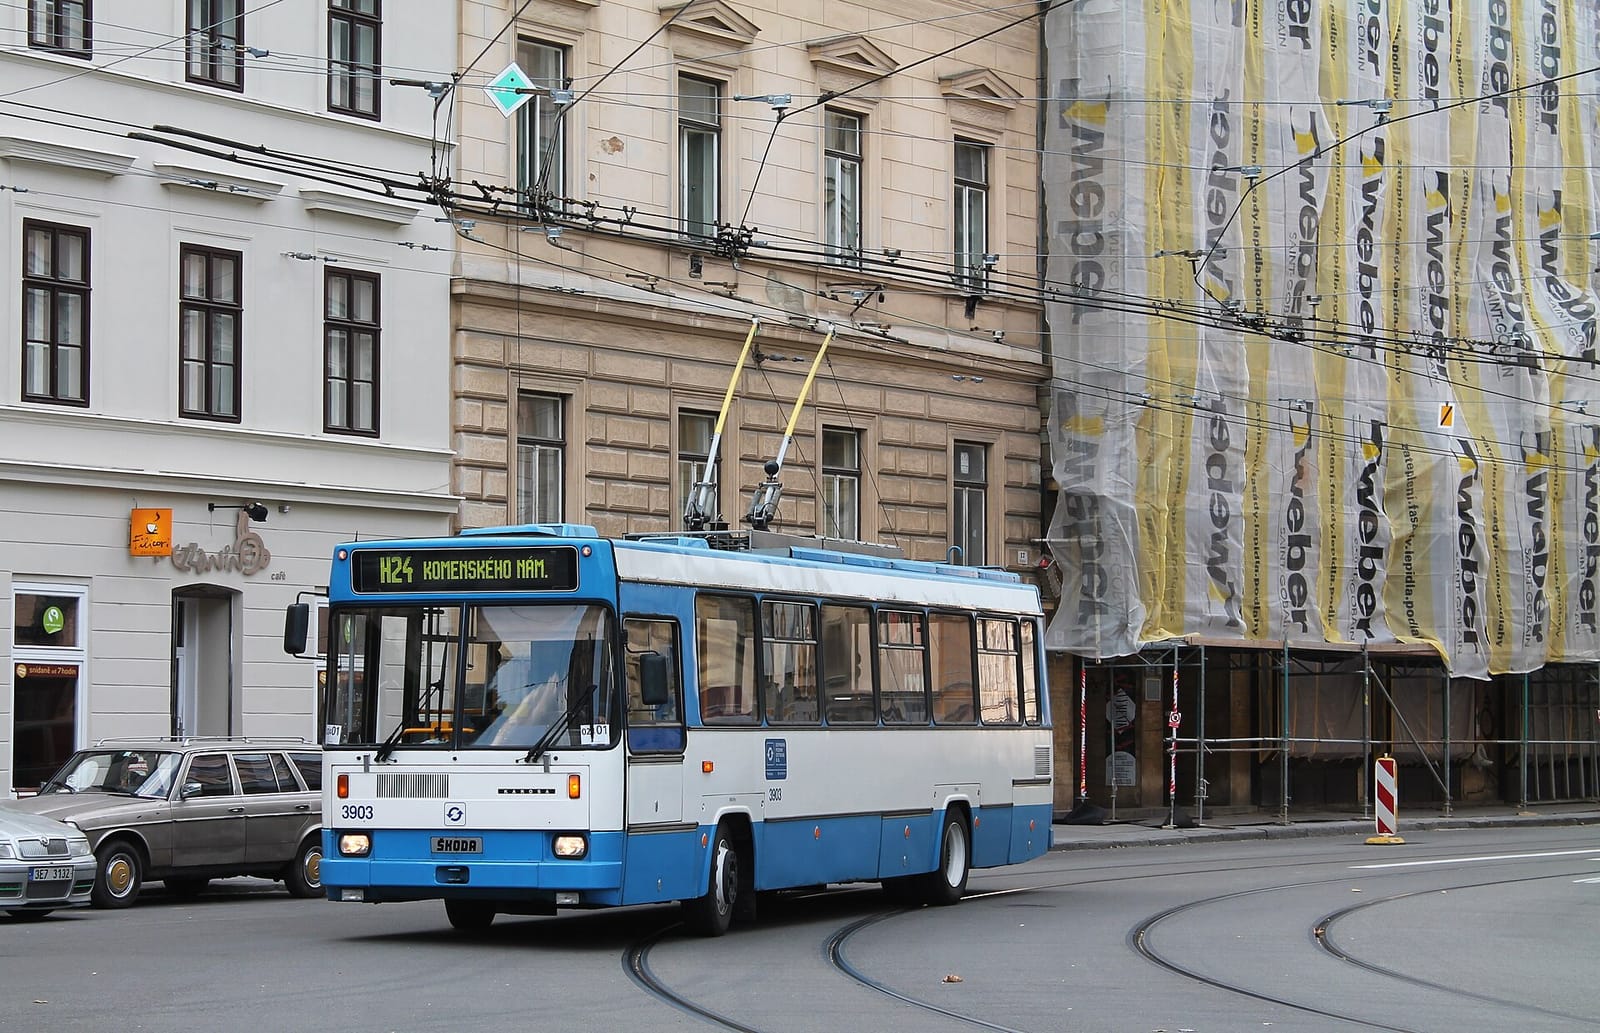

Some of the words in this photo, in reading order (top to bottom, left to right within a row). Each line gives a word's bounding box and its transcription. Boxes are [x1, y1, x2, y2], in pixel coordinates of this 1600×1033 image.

[379, 556, 414, 584] H24
[423, 556, 512, 581] KOMENSKÉHO
[516, 555, 549, 579] NÁM.
[1288, 447, 1311, 633] weber
[1357, 461, 1384, 640] weber
[1458, 475, 1480, 653] weber
[1526, 472, 1548, 643] weber
[1580, 465, 1600, 633] weber
[341, 805, 374, 820] 3903
[768, 788, 782, 802] 3903
[35, 869, 48, 880] 3E7
[436, 838, 477, 852] ŠKODA
